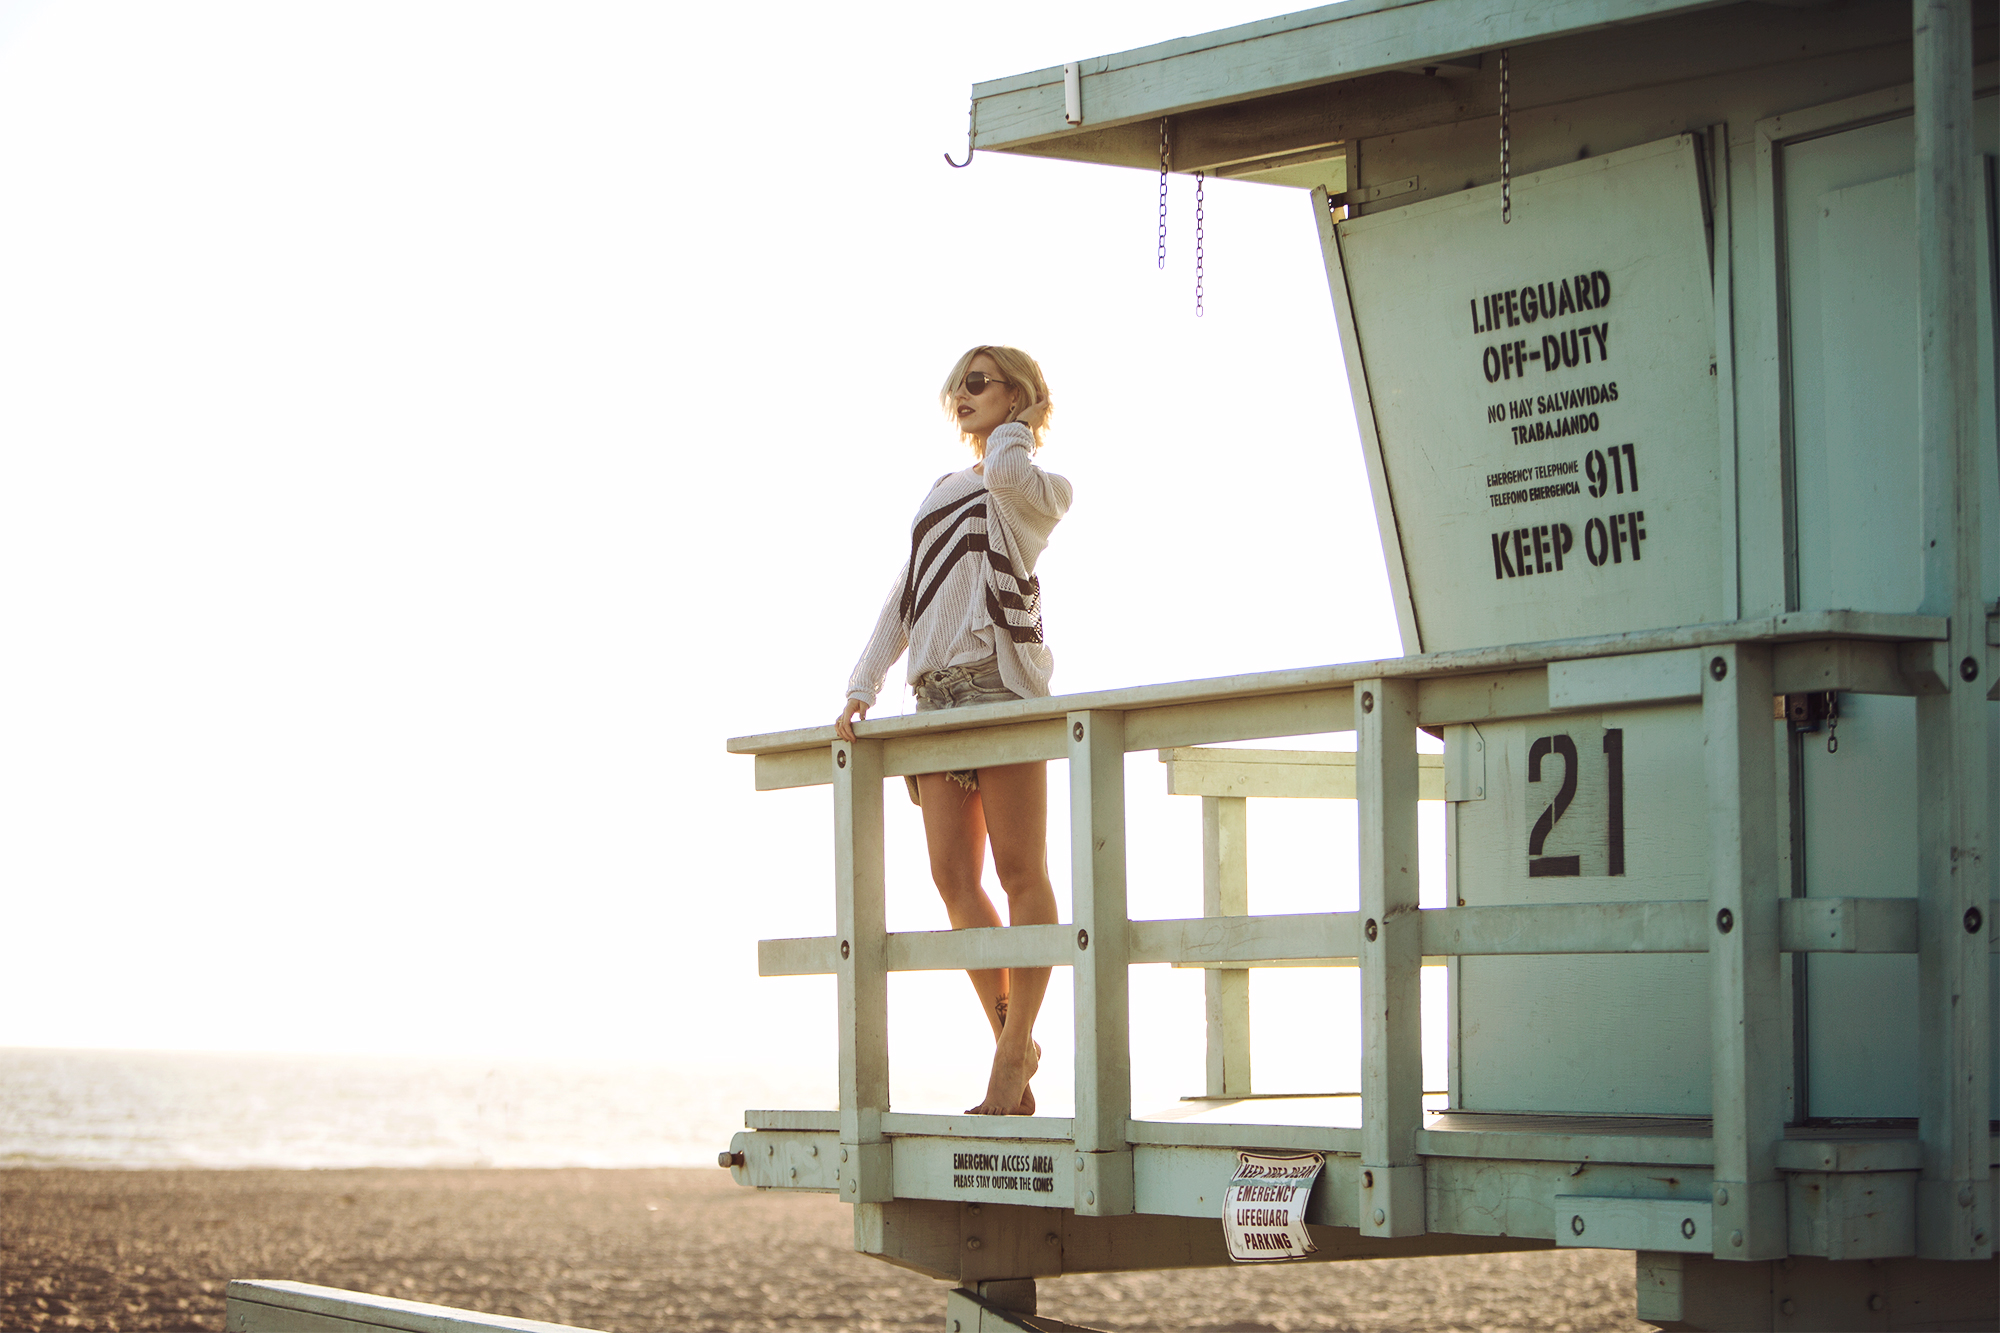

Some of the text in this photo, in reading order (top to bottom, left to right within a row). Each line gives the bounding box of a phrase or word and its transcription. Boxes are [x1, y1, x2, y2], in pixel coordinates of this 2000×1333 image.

[1470, 270, 1611, 334] LIFEGUARD
[1483, 322, 1609, 383] OFF-DUTY
[1487, 381, 1619, 423] NO HAY SALVAVIDAS
[1511, 411, 1600, 445] TRABAJANDO
[1487, 460, 1579, 487] EMERGENCY TELEPHONE
[1585, 443, 1639, 498] 911
[1489, 481, 1581, 507] TELEFONO EMERGENCIA
[1491, 511, 1647, 580] KEEP OFF
[1528, 728, 1625, 877] 21
[953, 1153, 1054, 1173] EMERGENCY ACCESS AREA
[953, 1174, 1054, 1192] PLEASE STAY OUTSIDE THE CONES
[1236, 1185, 1298, 1202] EMERGENCY
[1236, 1208, 1289, 1226] LIFEGUARD
[1244, 1233, 1293, 1250] PARKING
